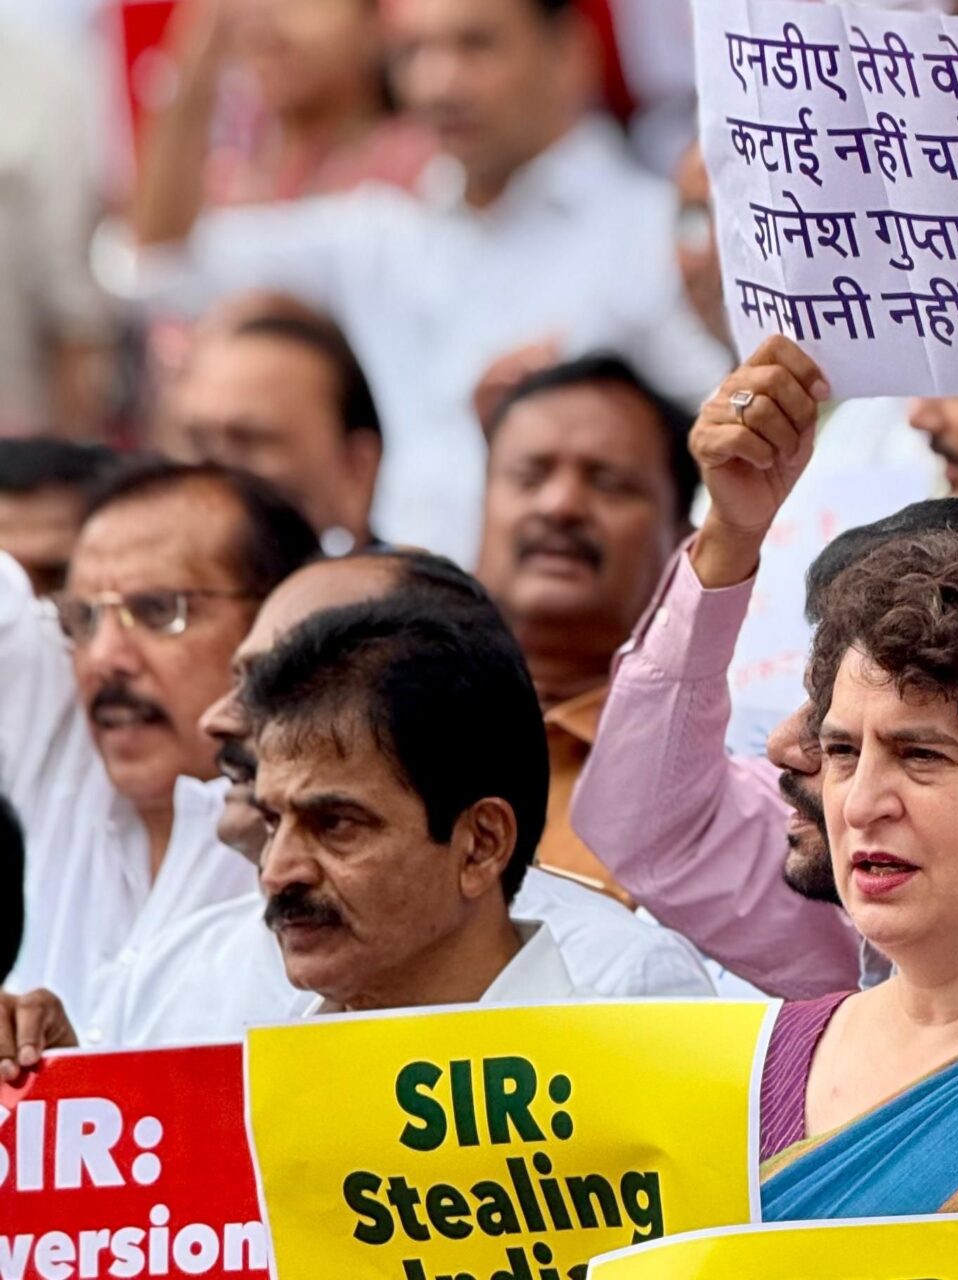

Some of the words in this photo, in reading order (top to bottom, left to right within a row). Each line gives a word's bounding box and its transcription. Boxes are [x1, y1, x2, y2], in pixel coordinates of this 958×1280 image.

[725, 22, 847, 102] एनडीए
[850, 26, 920, 98] तेरी
[726, 107, 823, 186] कटाई
[827, 112, 913, 183] नहीं
[749, 190, 860, 260] ज्ञानेश
[735, 276, 875, 340] मनमानी
[395, 1056, 575, 1151] SIR:
[343, 1151, 666, 1245] Stealing
[0, 1203, 268, 1280] version
